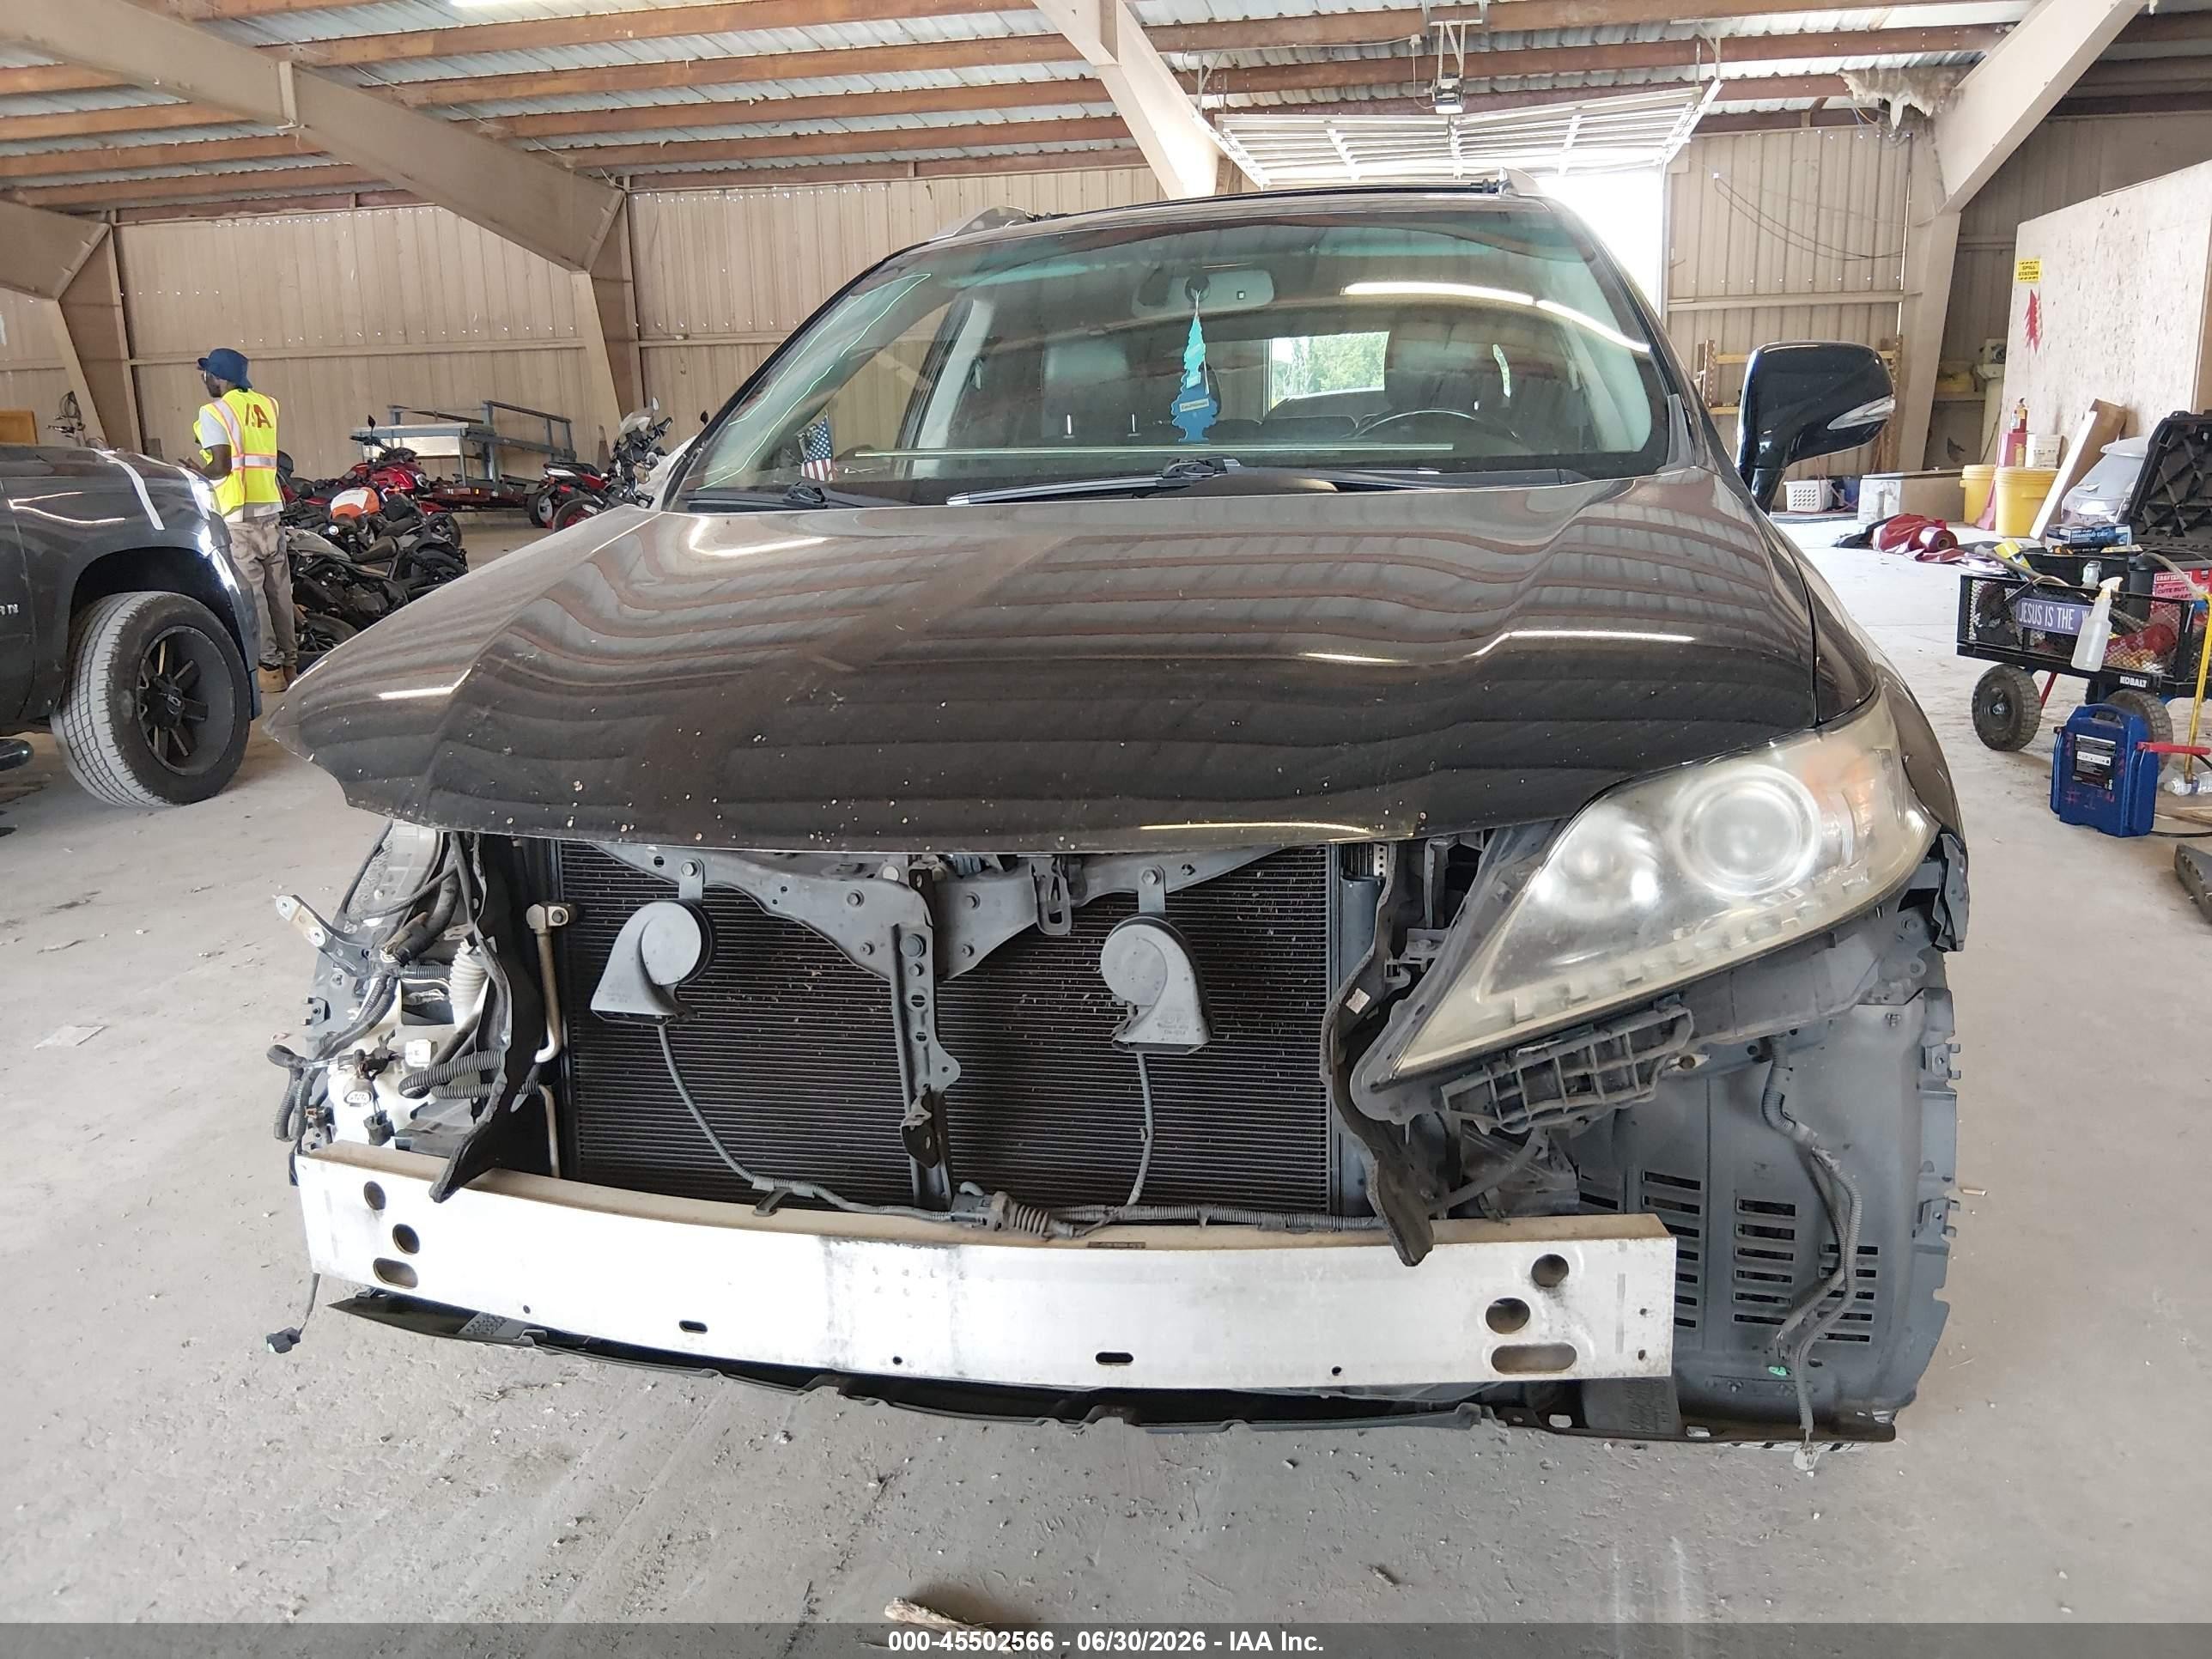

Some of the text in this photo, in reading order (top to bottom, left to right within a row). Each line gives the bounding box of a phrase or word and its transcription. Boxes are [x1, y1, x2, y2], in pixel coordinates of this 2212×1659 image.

[2019, 602, 2043, 626] JESUS
[2044, 605, 2055, 628] IS
[2057, 607, 2075, 630] THE
[2119, 675, 2148, 688] KOBALT
